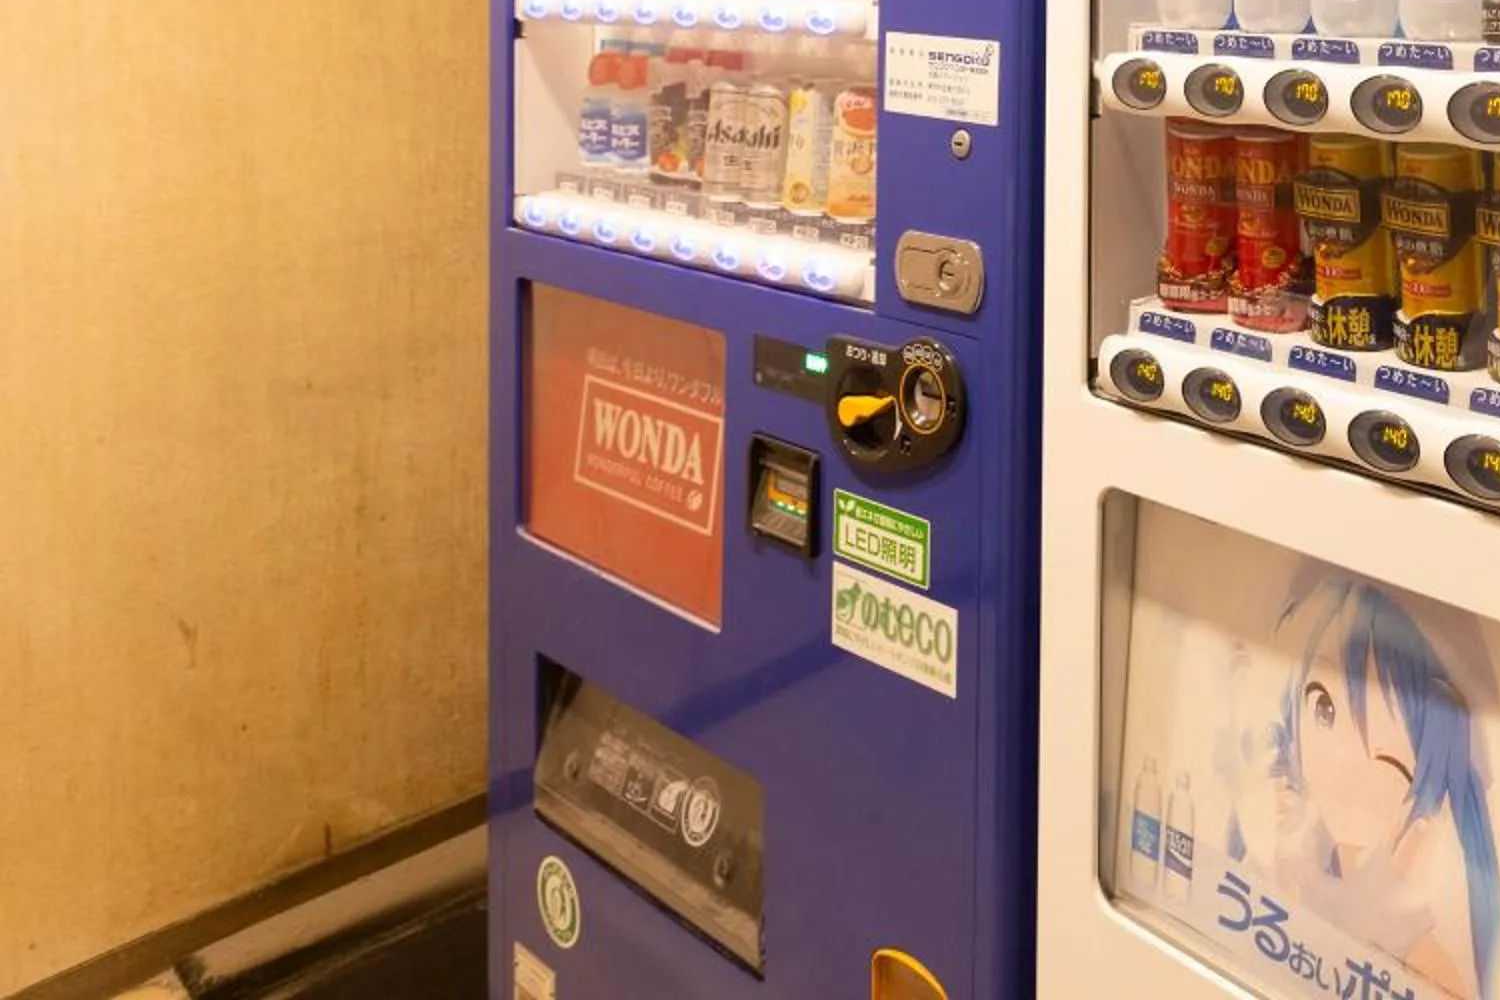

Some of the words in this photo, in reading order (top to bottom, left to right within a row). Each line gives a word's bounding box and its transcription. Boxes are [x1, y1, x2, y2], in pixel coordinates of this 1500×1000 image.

[1387, 89, 1411, 109] 170
[707, 120, 780, 150] Asahi
[1296, 183, 1358, 217] WONDA
[1386, 200, 1447, 233] WONDA
[1327, 307, 1371, 347] 休憩
[1412, 325, 1460, 369] 休憩
[593, 397, 705, 486] WONDA
[1384, 429, 1407, 447] 140
[844, 521, 917, 574] LED照明
